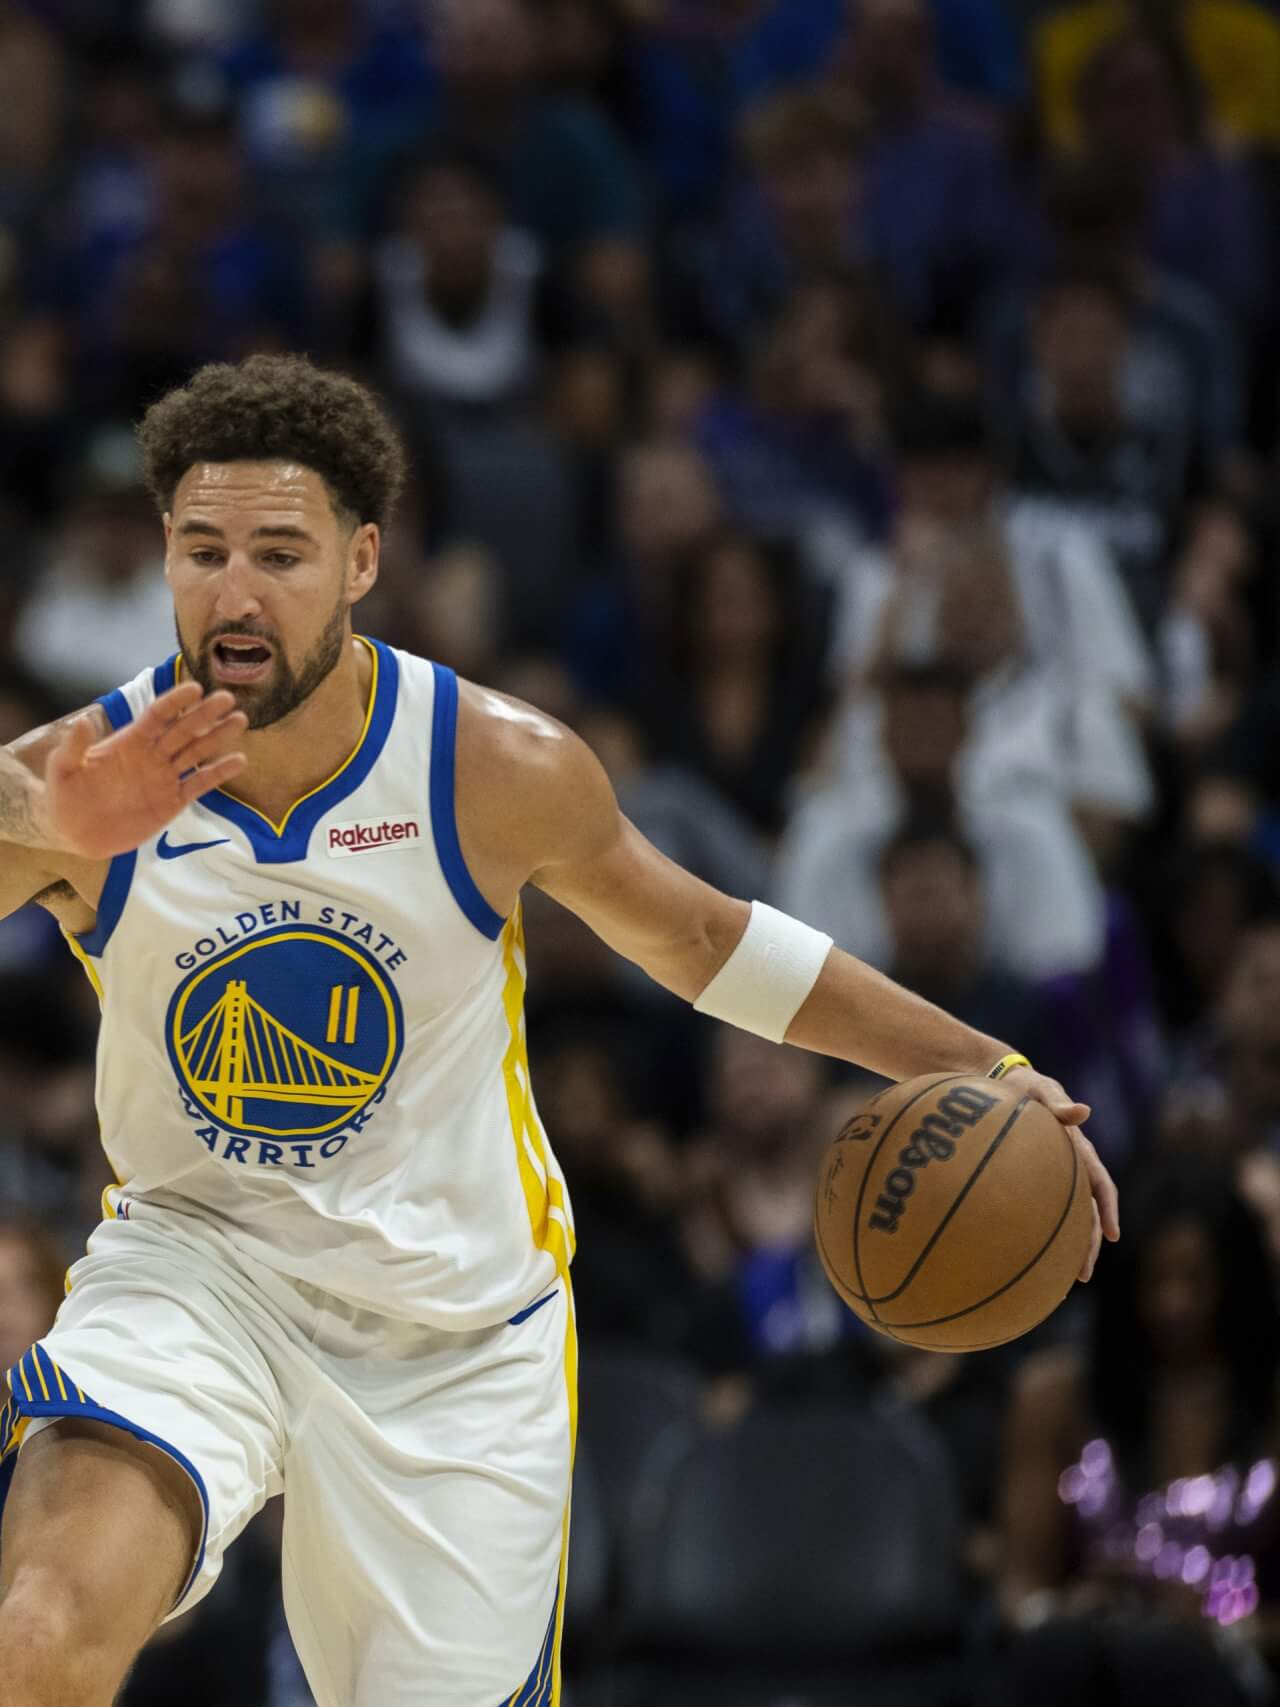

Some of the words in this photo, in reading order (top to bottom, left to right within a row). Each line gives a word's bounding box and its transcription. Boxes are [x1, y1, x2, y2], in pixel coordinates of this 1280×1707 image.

[328, 817, 420, 850] Rakuten
[175, 900, 302, 971] GOLDEN
[317, 906, 409, 971] STATE
[325, 983, 361, 1045] 11
[867, 1085, 999, 1236] Wilson
